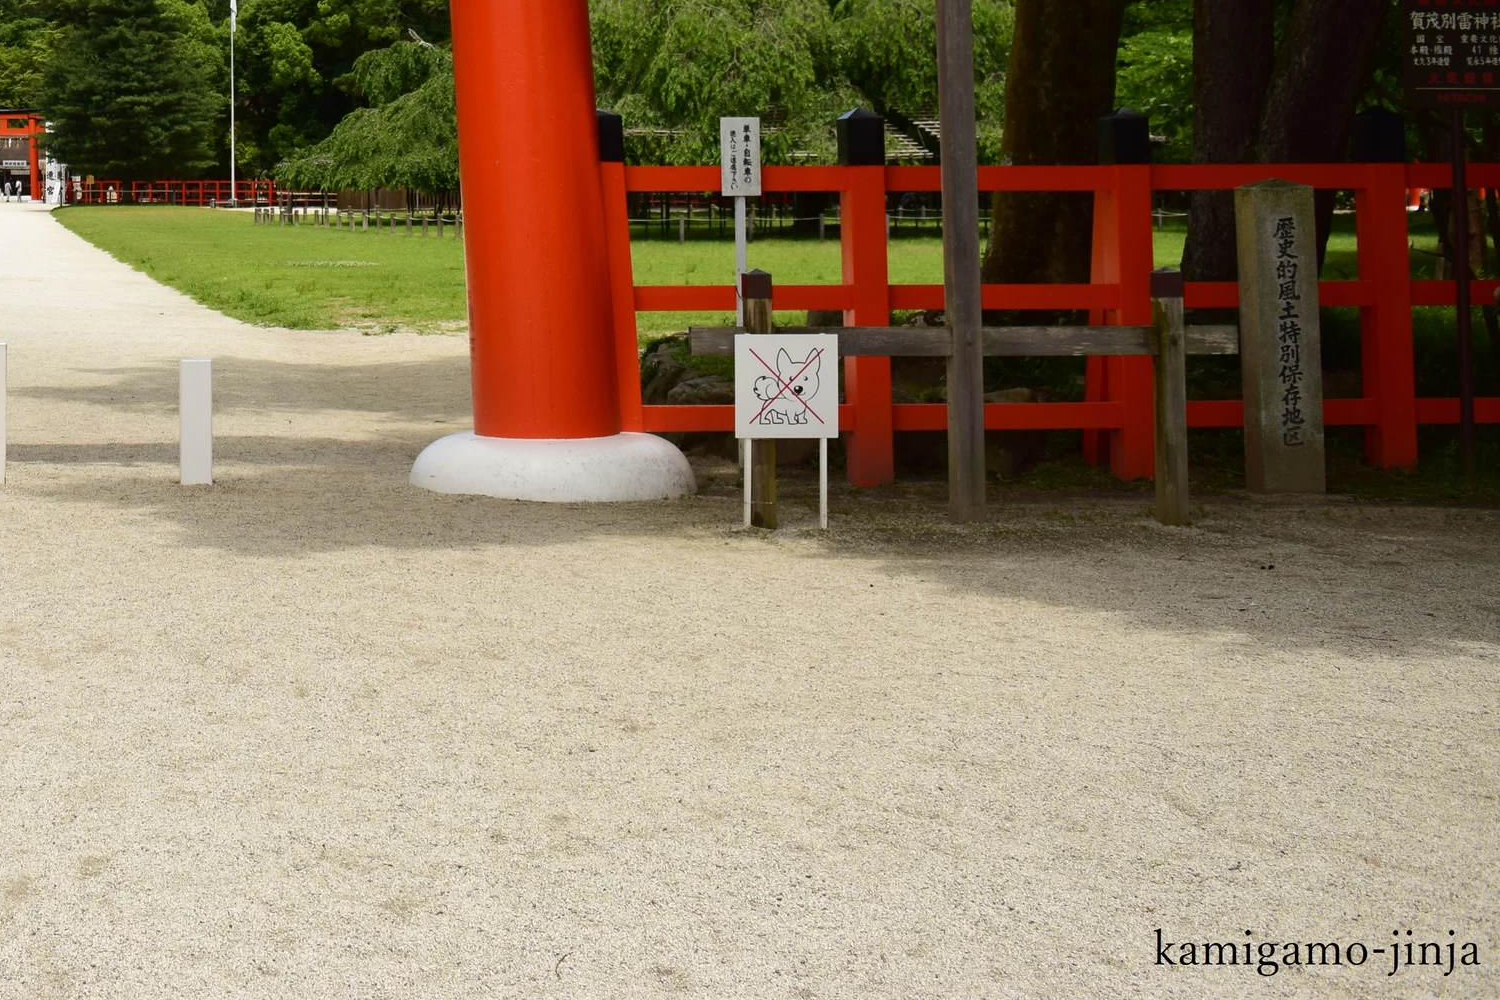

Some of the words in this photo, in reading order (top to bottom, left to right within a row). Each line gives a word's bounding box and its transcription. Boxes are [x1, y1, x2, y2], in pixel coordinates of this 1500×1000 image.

[1460, 34, 1500, 44] 重要文化
[1466, 57, 1500, 67] 寛永5年造
[1273, 217, 1305, 446] 歴史的風土特別保存地区
